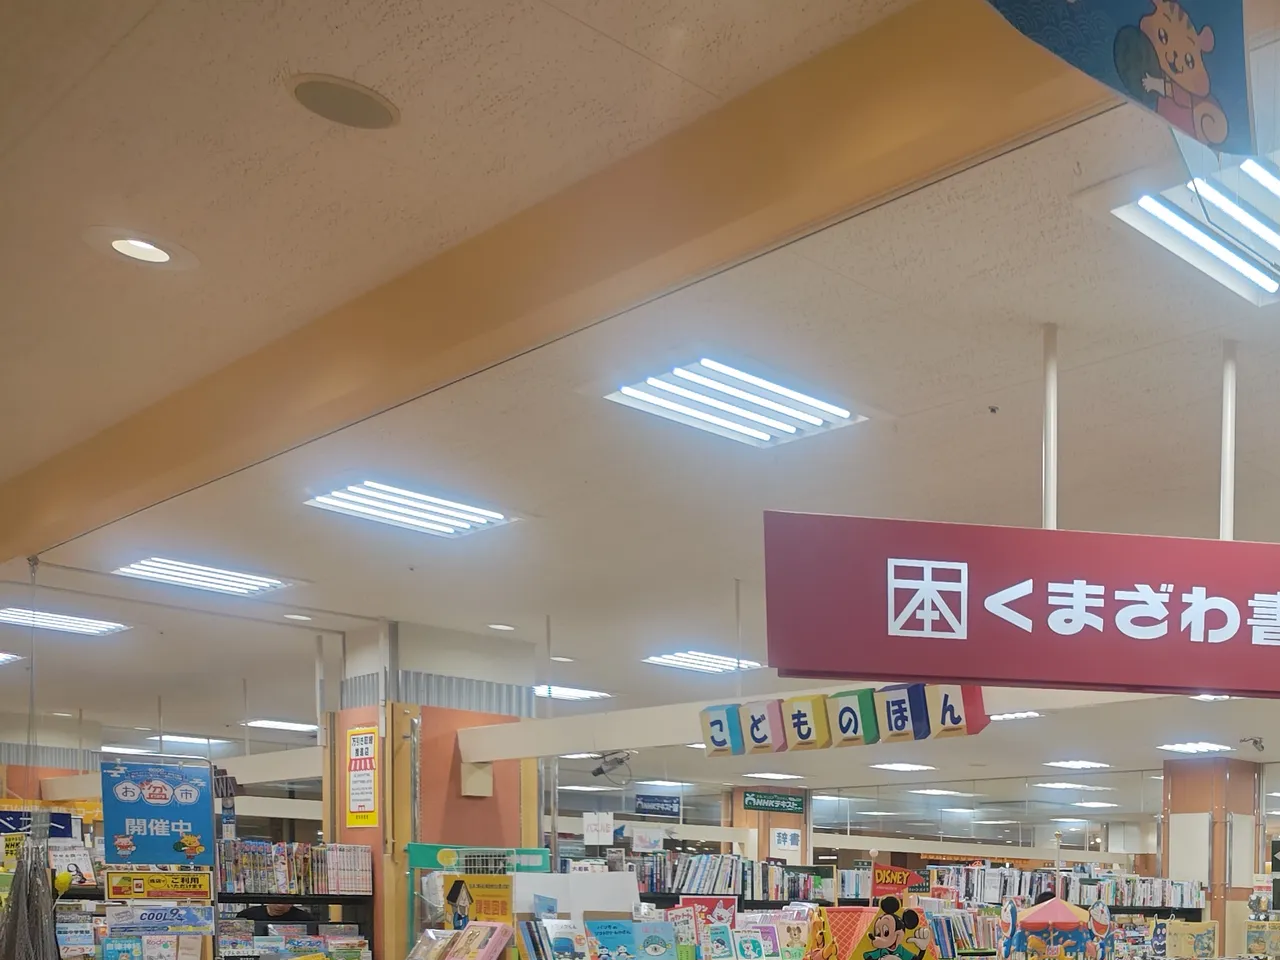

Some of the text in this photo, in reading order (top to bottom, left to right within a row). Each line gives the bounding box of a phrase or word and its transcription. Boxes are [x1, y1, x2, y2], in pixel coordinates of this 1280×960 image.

[708, 694, 964, 747] こどものほん
[125, 818, 192, 836] 開催中
[776, 831, 800, 847] 辞書
[874, 867, 910, 885] DISNEY
